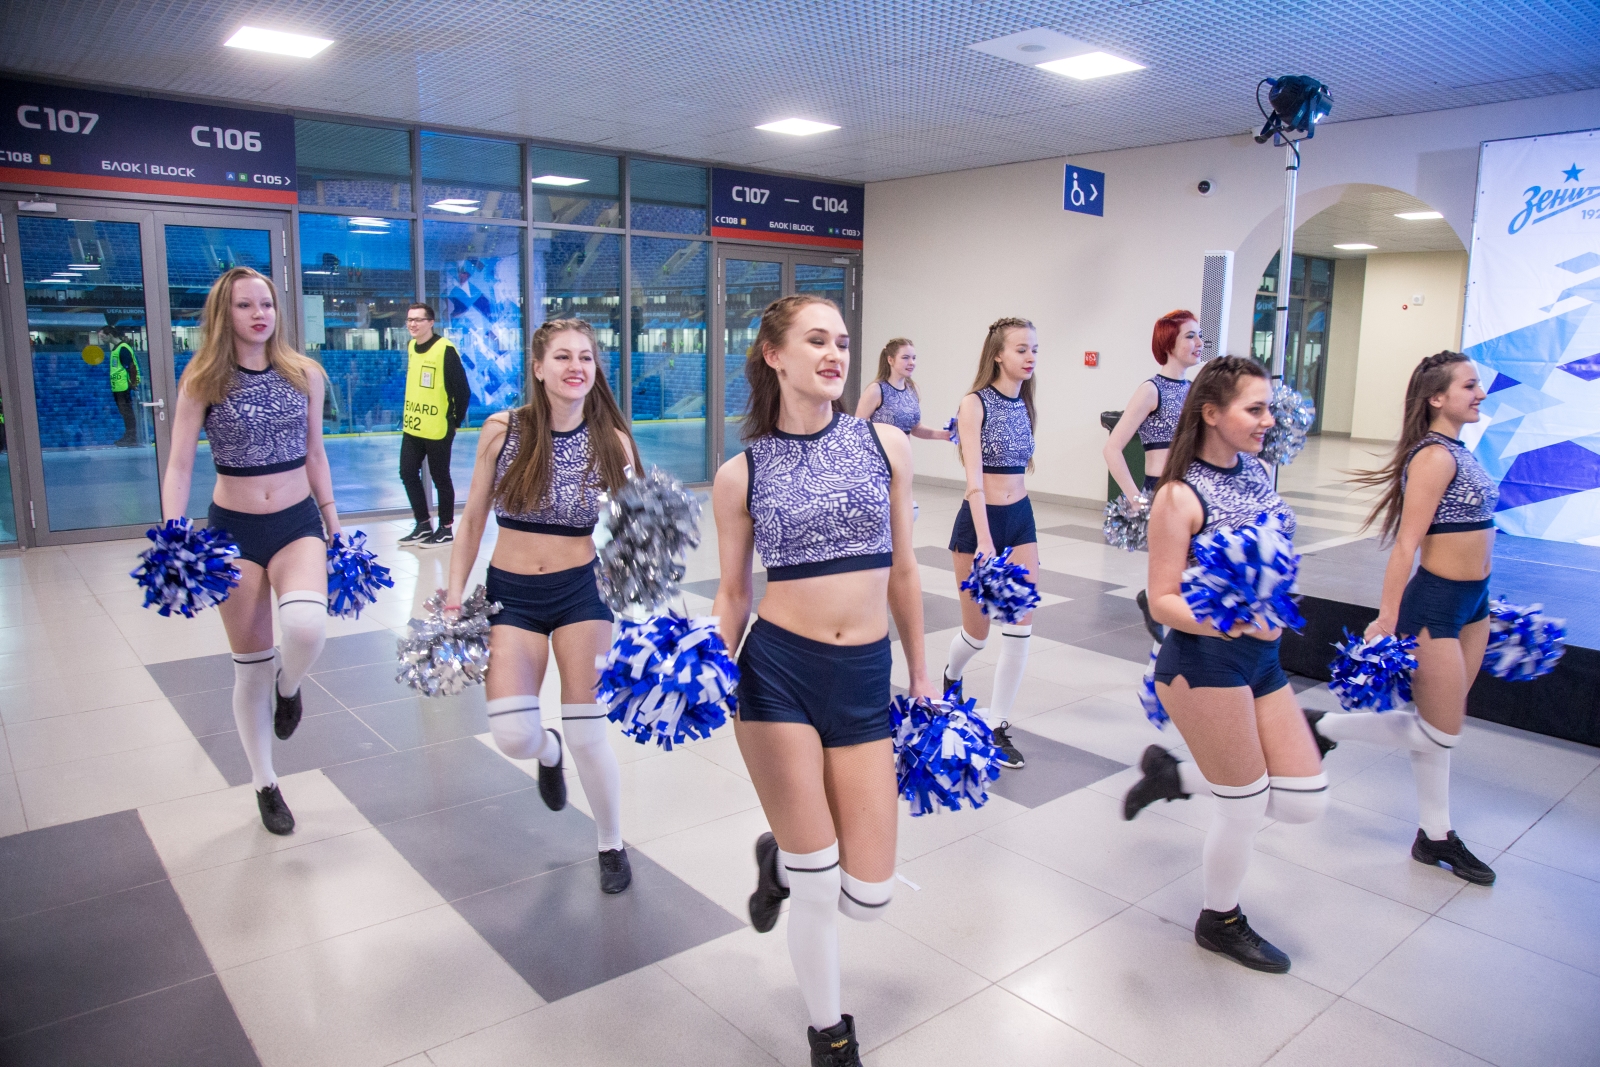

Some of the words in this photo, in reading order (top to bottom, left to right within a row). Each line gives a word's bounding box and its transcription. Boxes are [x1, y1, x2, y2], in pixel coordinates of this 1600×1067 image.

[17, 104, 99, 135] C107
[191, 125, 262, 152] C106
[101, 160, 142, 174] БЛОК
[150, 164, 196, 178] BLOCK
[253, 174, 282, 185] C105
[732, 185, 770, 204] C107
[812, 195, 848, 214] C104
[720, 216, 738, 225] C108
[769, 221, 789, 230] БЛОК
[792, 223, 815, 233] BLOCK
[841, 228, 857, 237] C103
